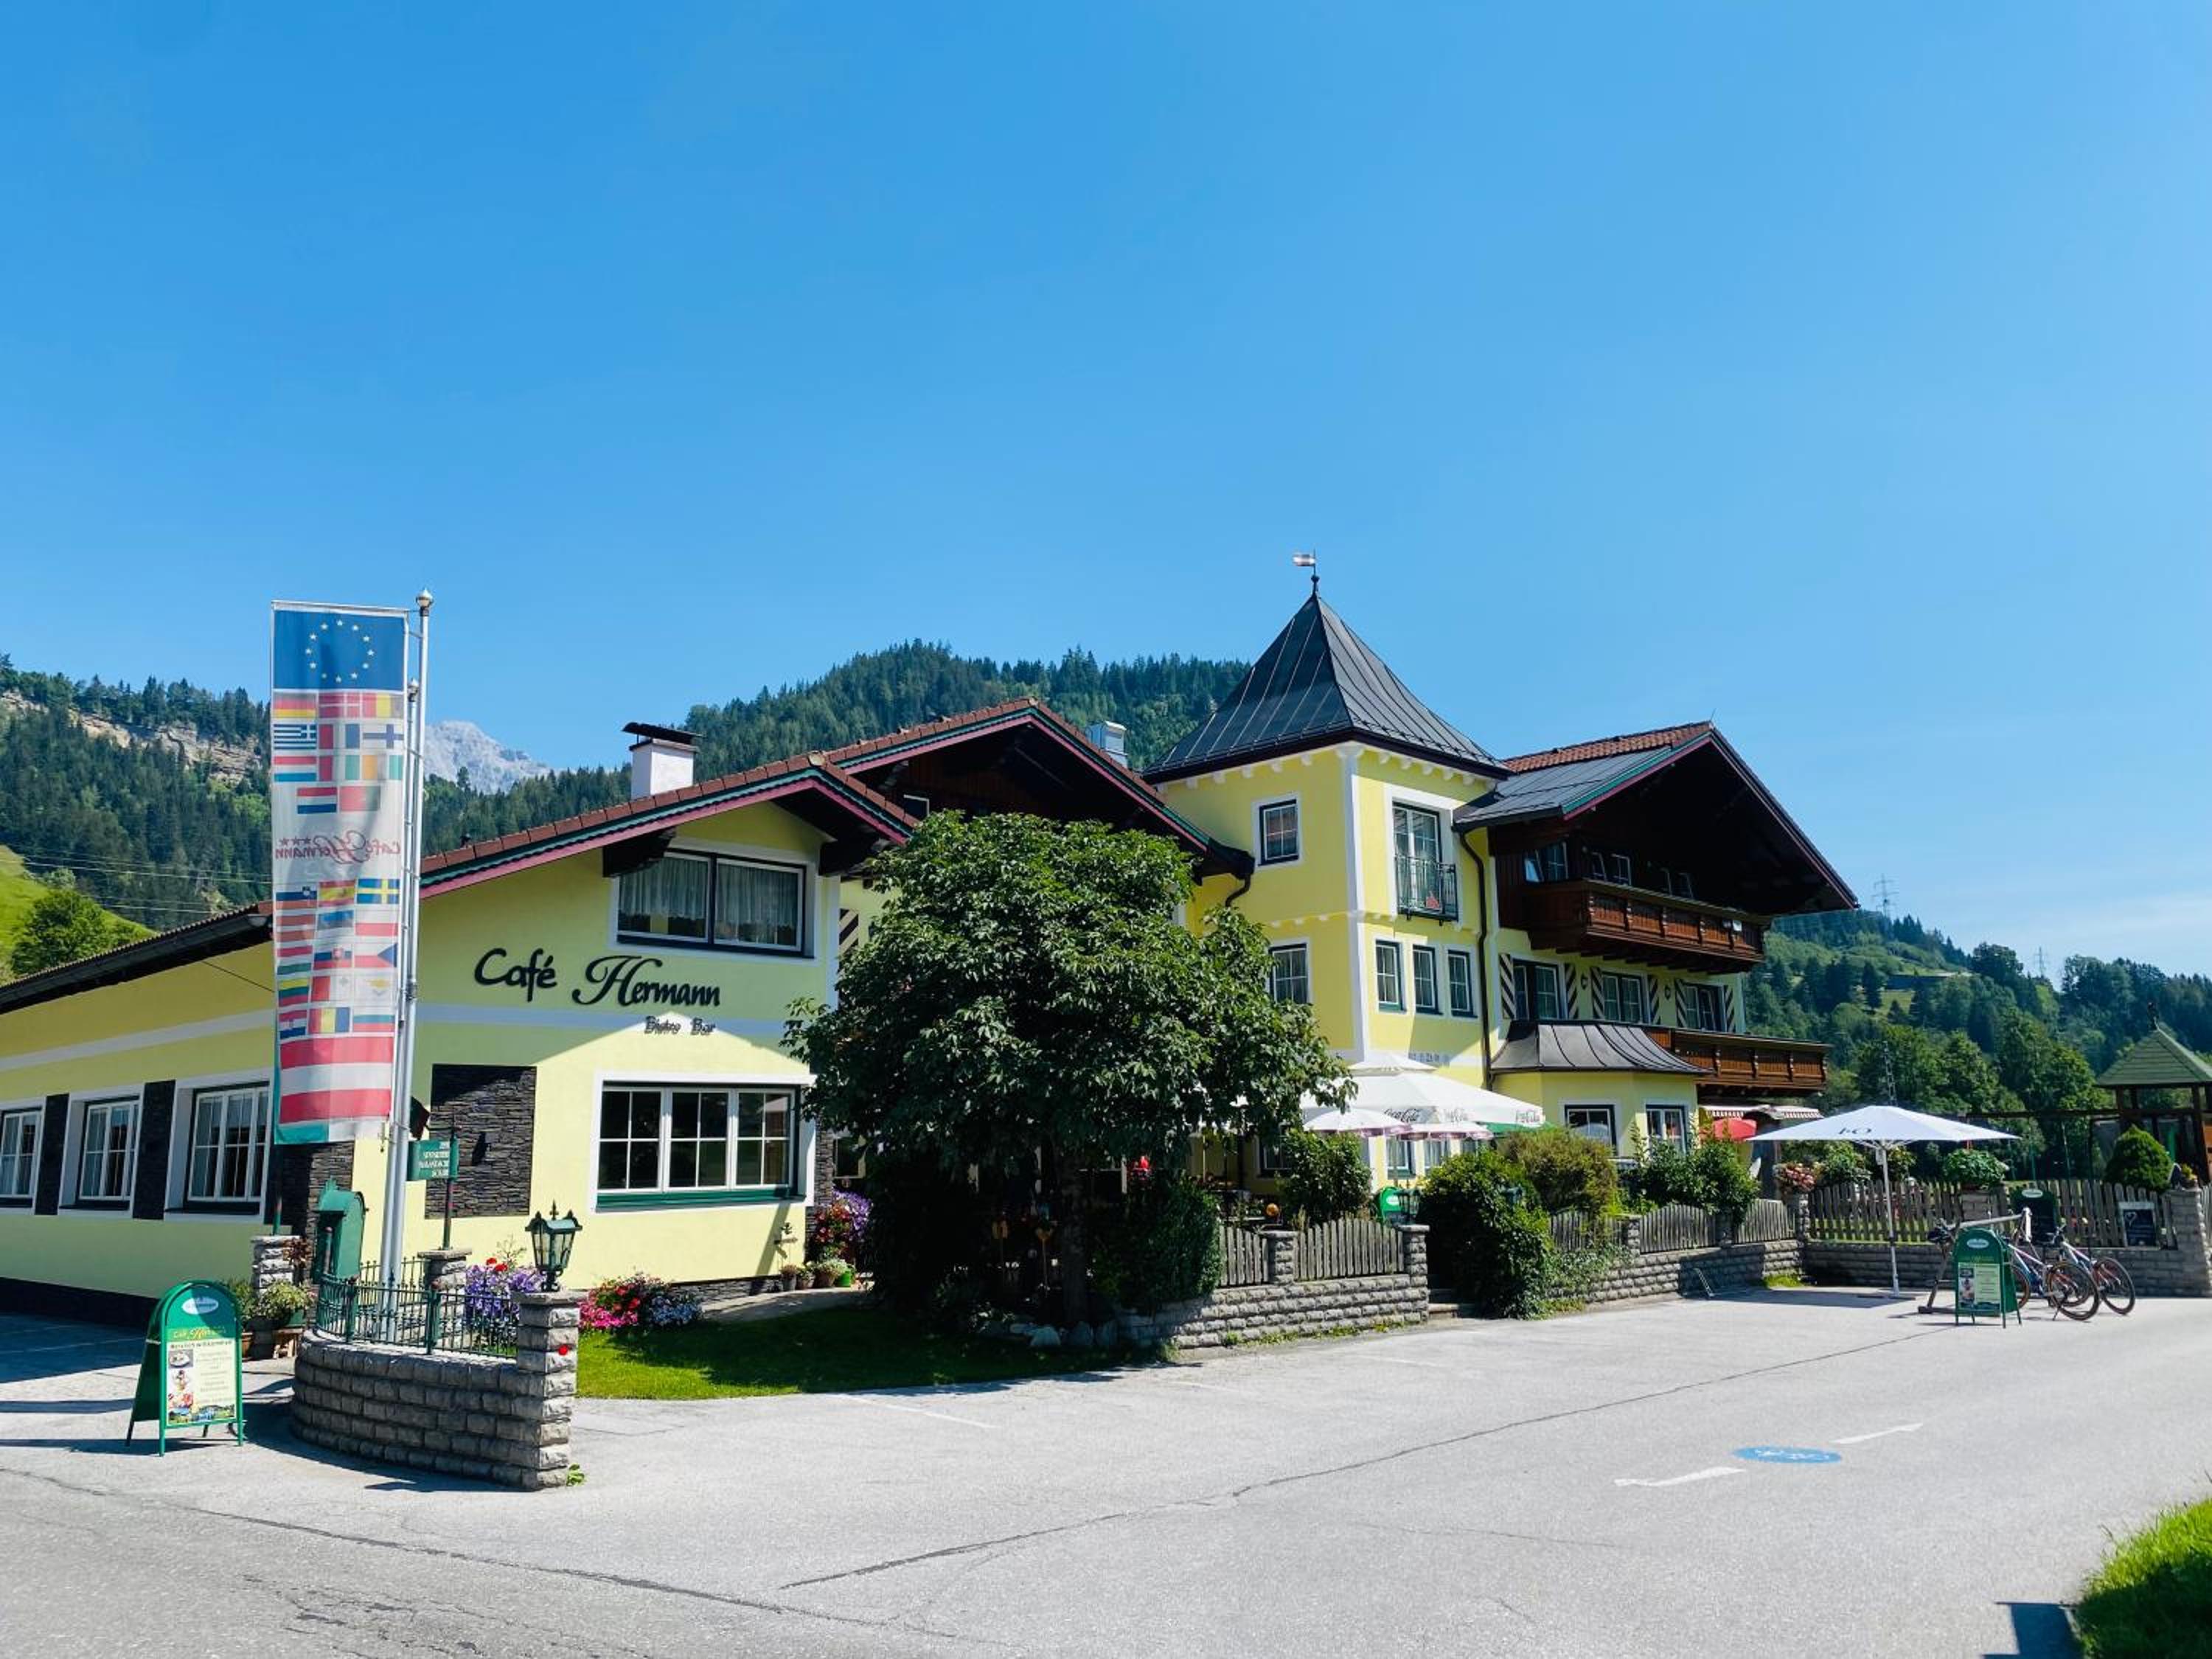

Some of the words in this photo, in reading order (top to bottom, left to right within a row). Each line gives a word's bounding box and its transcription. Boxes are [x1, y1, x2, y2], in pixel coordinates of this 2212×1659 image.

[474, 947, 557, 1002] Café
[572, 955, 720, 1006] Hermann
[644, 1015, 681, 1034] Bistro
[689, 1017, 716, 1035] Bar
